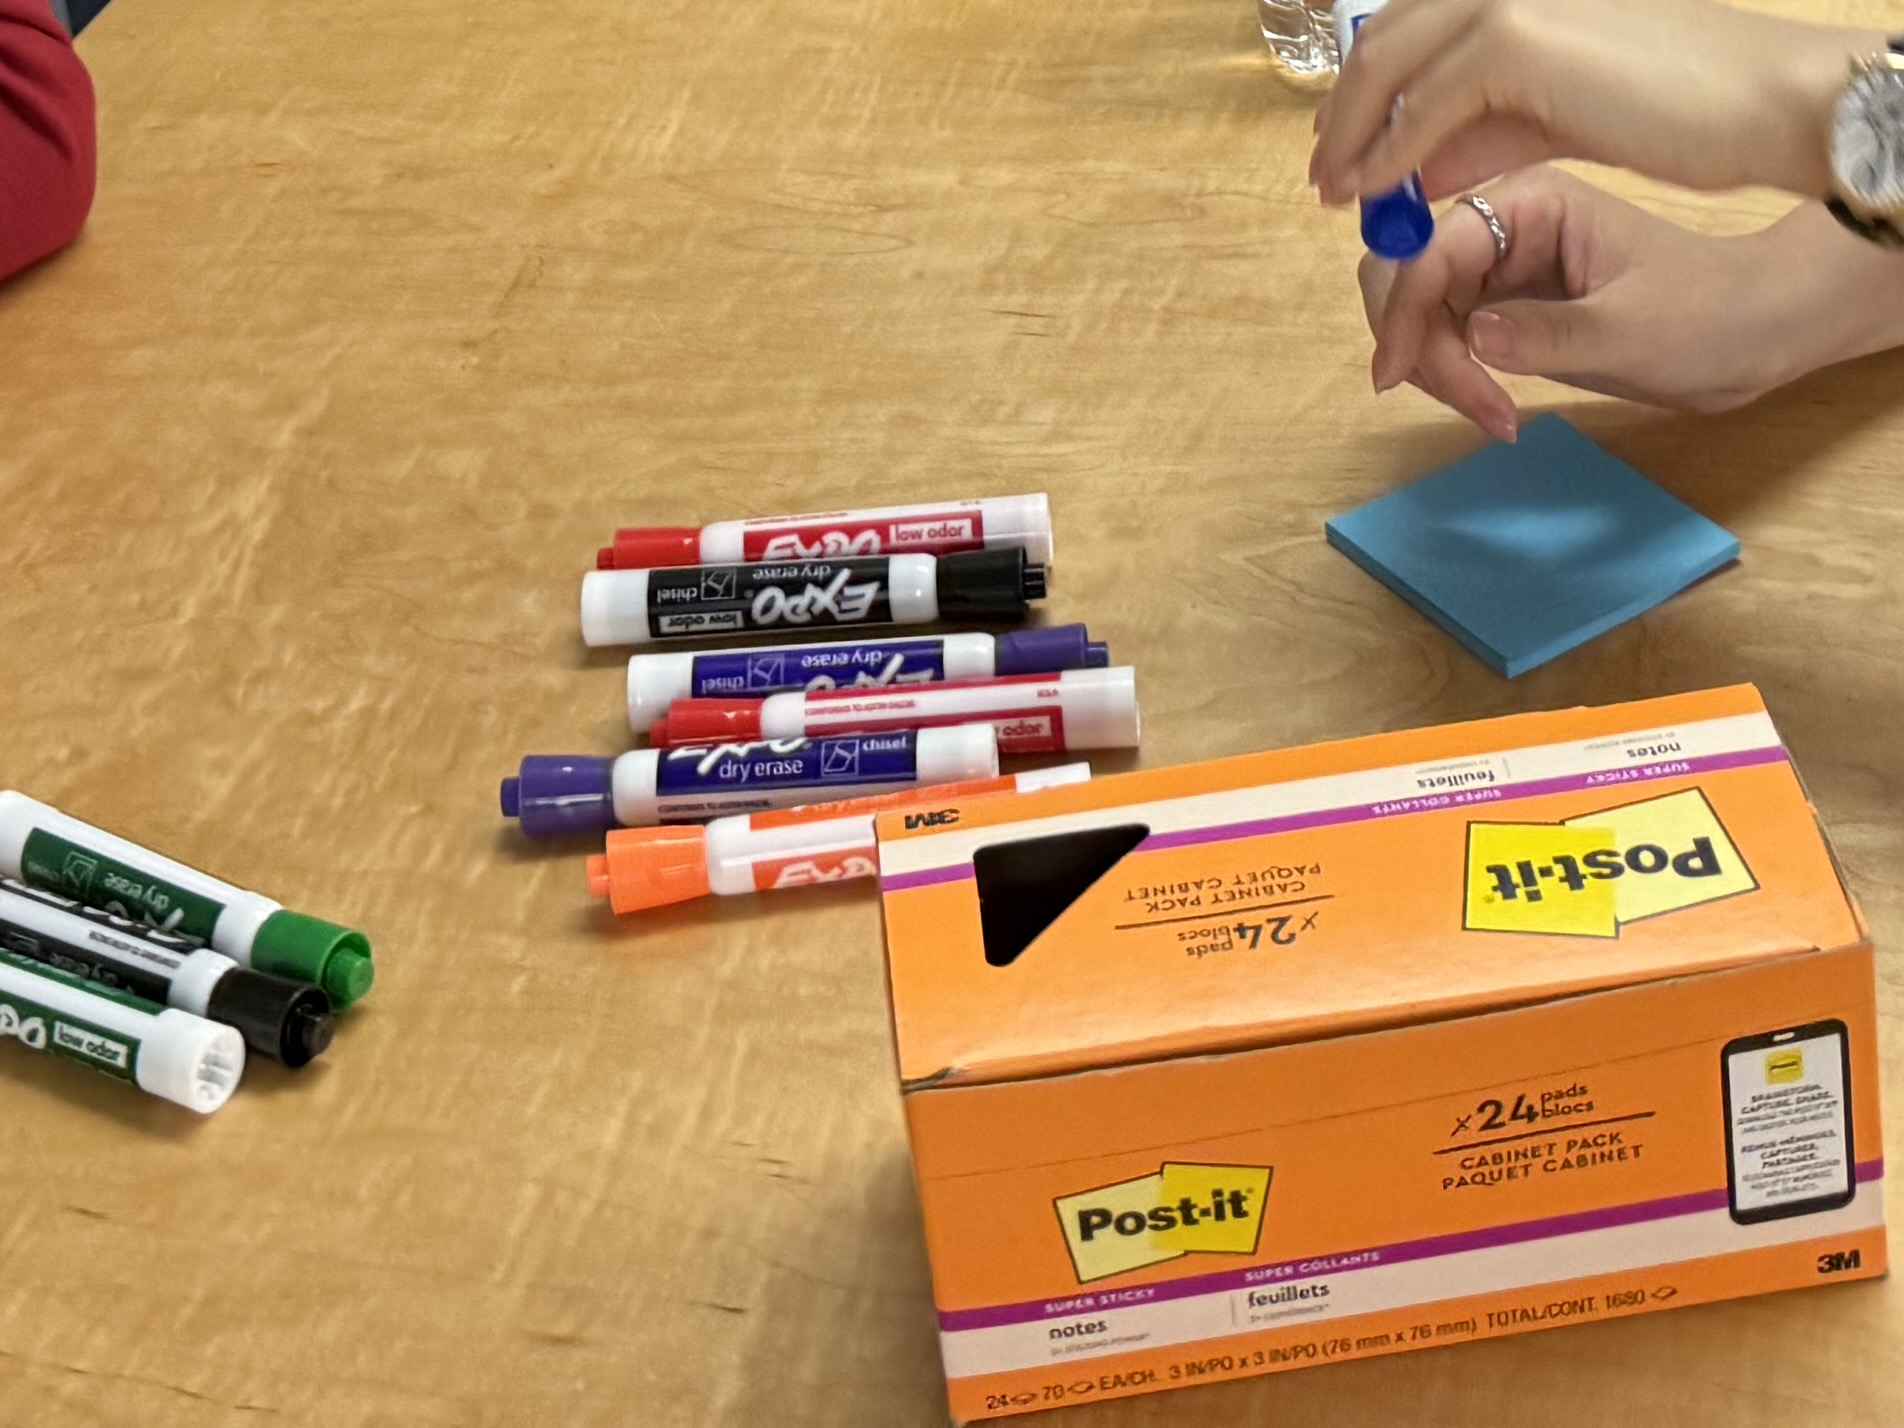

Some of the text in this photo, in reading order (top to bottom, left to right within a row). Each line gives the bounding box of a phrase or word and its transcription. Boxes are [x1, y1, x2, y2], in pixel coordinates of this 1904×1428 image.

[896, 522, 965, 541] low odor
[752, 564, 832, 581] dry erase
[656, 586, 698, 604] chisel
[750, 568, 881, 625] EXPO
[667, 614, 738, 631] low odor
[801, 649, 884, 668] dry erase
[701, 675, 745, 694] chisel
[1002, 721, 1043, 737] odor
[862, 736, 907, 752] chisel
[1626, 741, 1682, 759] notes
[718, 758, 804, 783] dry erase
[1417, 768, 1496, 789] feuillets
[904, 807, 960, 831] 3M
[1485, 836, 1723, 903] Post-it
[1123, 862, 1322, 903] PAQUET CABINET
[1146, 880, 1307, 914] CABINET PACK
[1177, 923, 1231, 943] blocs
[1185, 940, 1235, 958] pads
[57, 1024, 121, 1062] low odor
[1539, 1082, 1589, 1104] pads
[1540, 1099, 1595, 1119] blocs
[1459, 1131, 1624, 1171] CABINET PACK
[1442, 1144, 1644, 1190] PAQUET CABINET
[1078, 1187, 1250, 1242] Post-it
[1244, 1250, 1381, 1283] SUPER COLLANTS
[1816, 1248, 1861, 1274] 3M
[1044, 1287, 1156, 1315] SUPER STICKY
[1247, 1281, 1331, 1309] feuillets
[1048, 1317, 1109, 1341] notes
